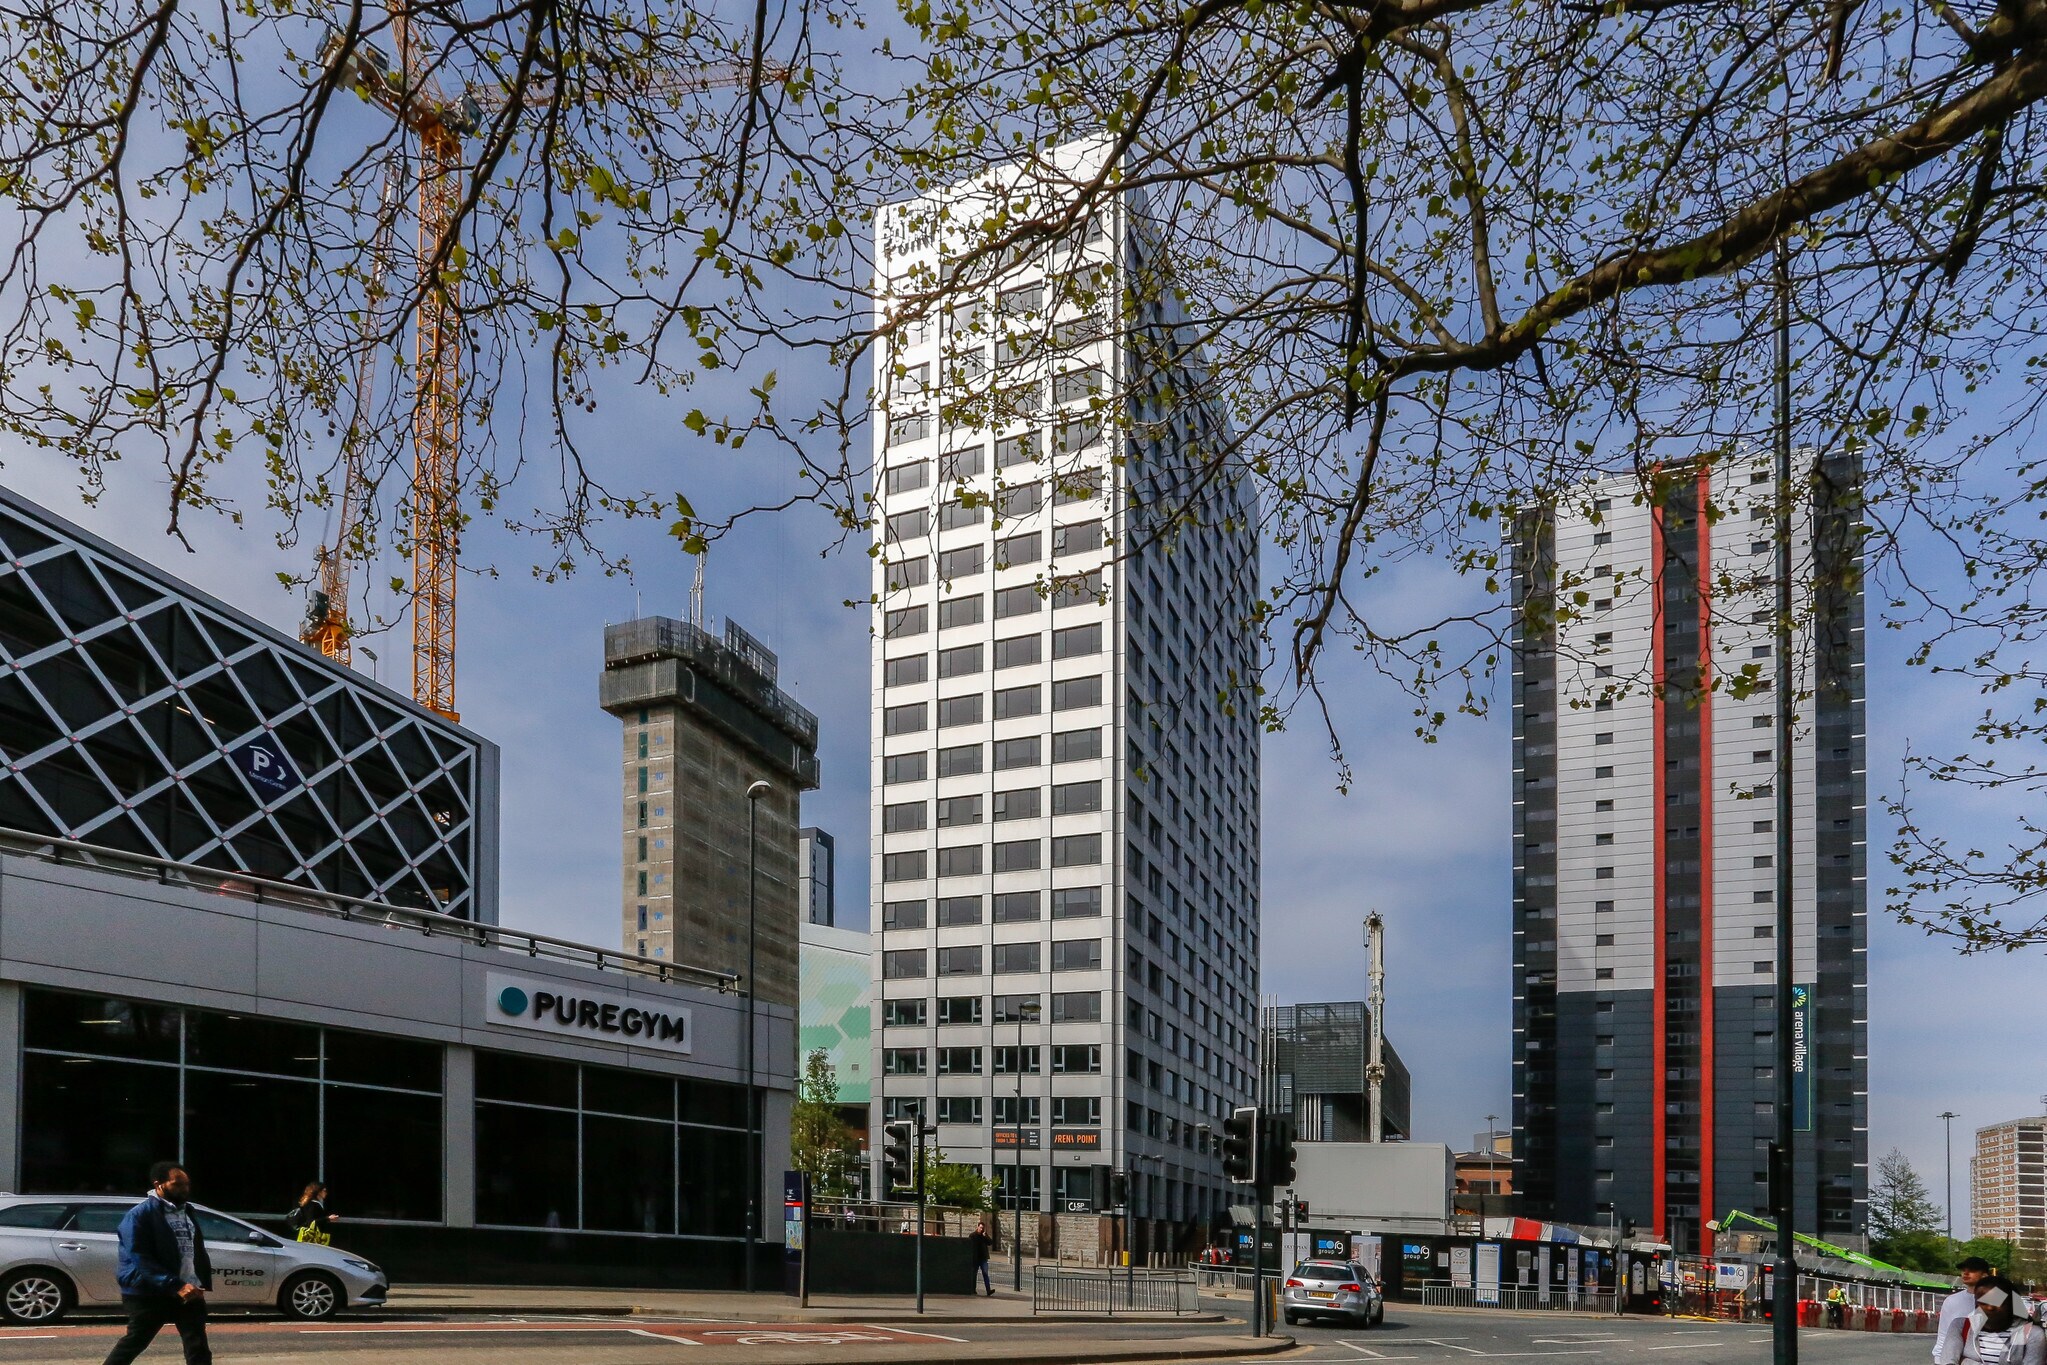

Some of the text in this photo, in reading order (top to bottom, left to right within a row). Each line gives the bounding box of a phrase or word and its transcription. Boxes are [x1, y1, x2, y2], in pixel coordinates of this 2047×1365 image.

[254, 750, 270, 771] P
[534, 991, 684, 1043] PUREGYM
[1792, 1011, 1807, 1073] arena village
[1077, 1135, 1097, 1143] POINT
